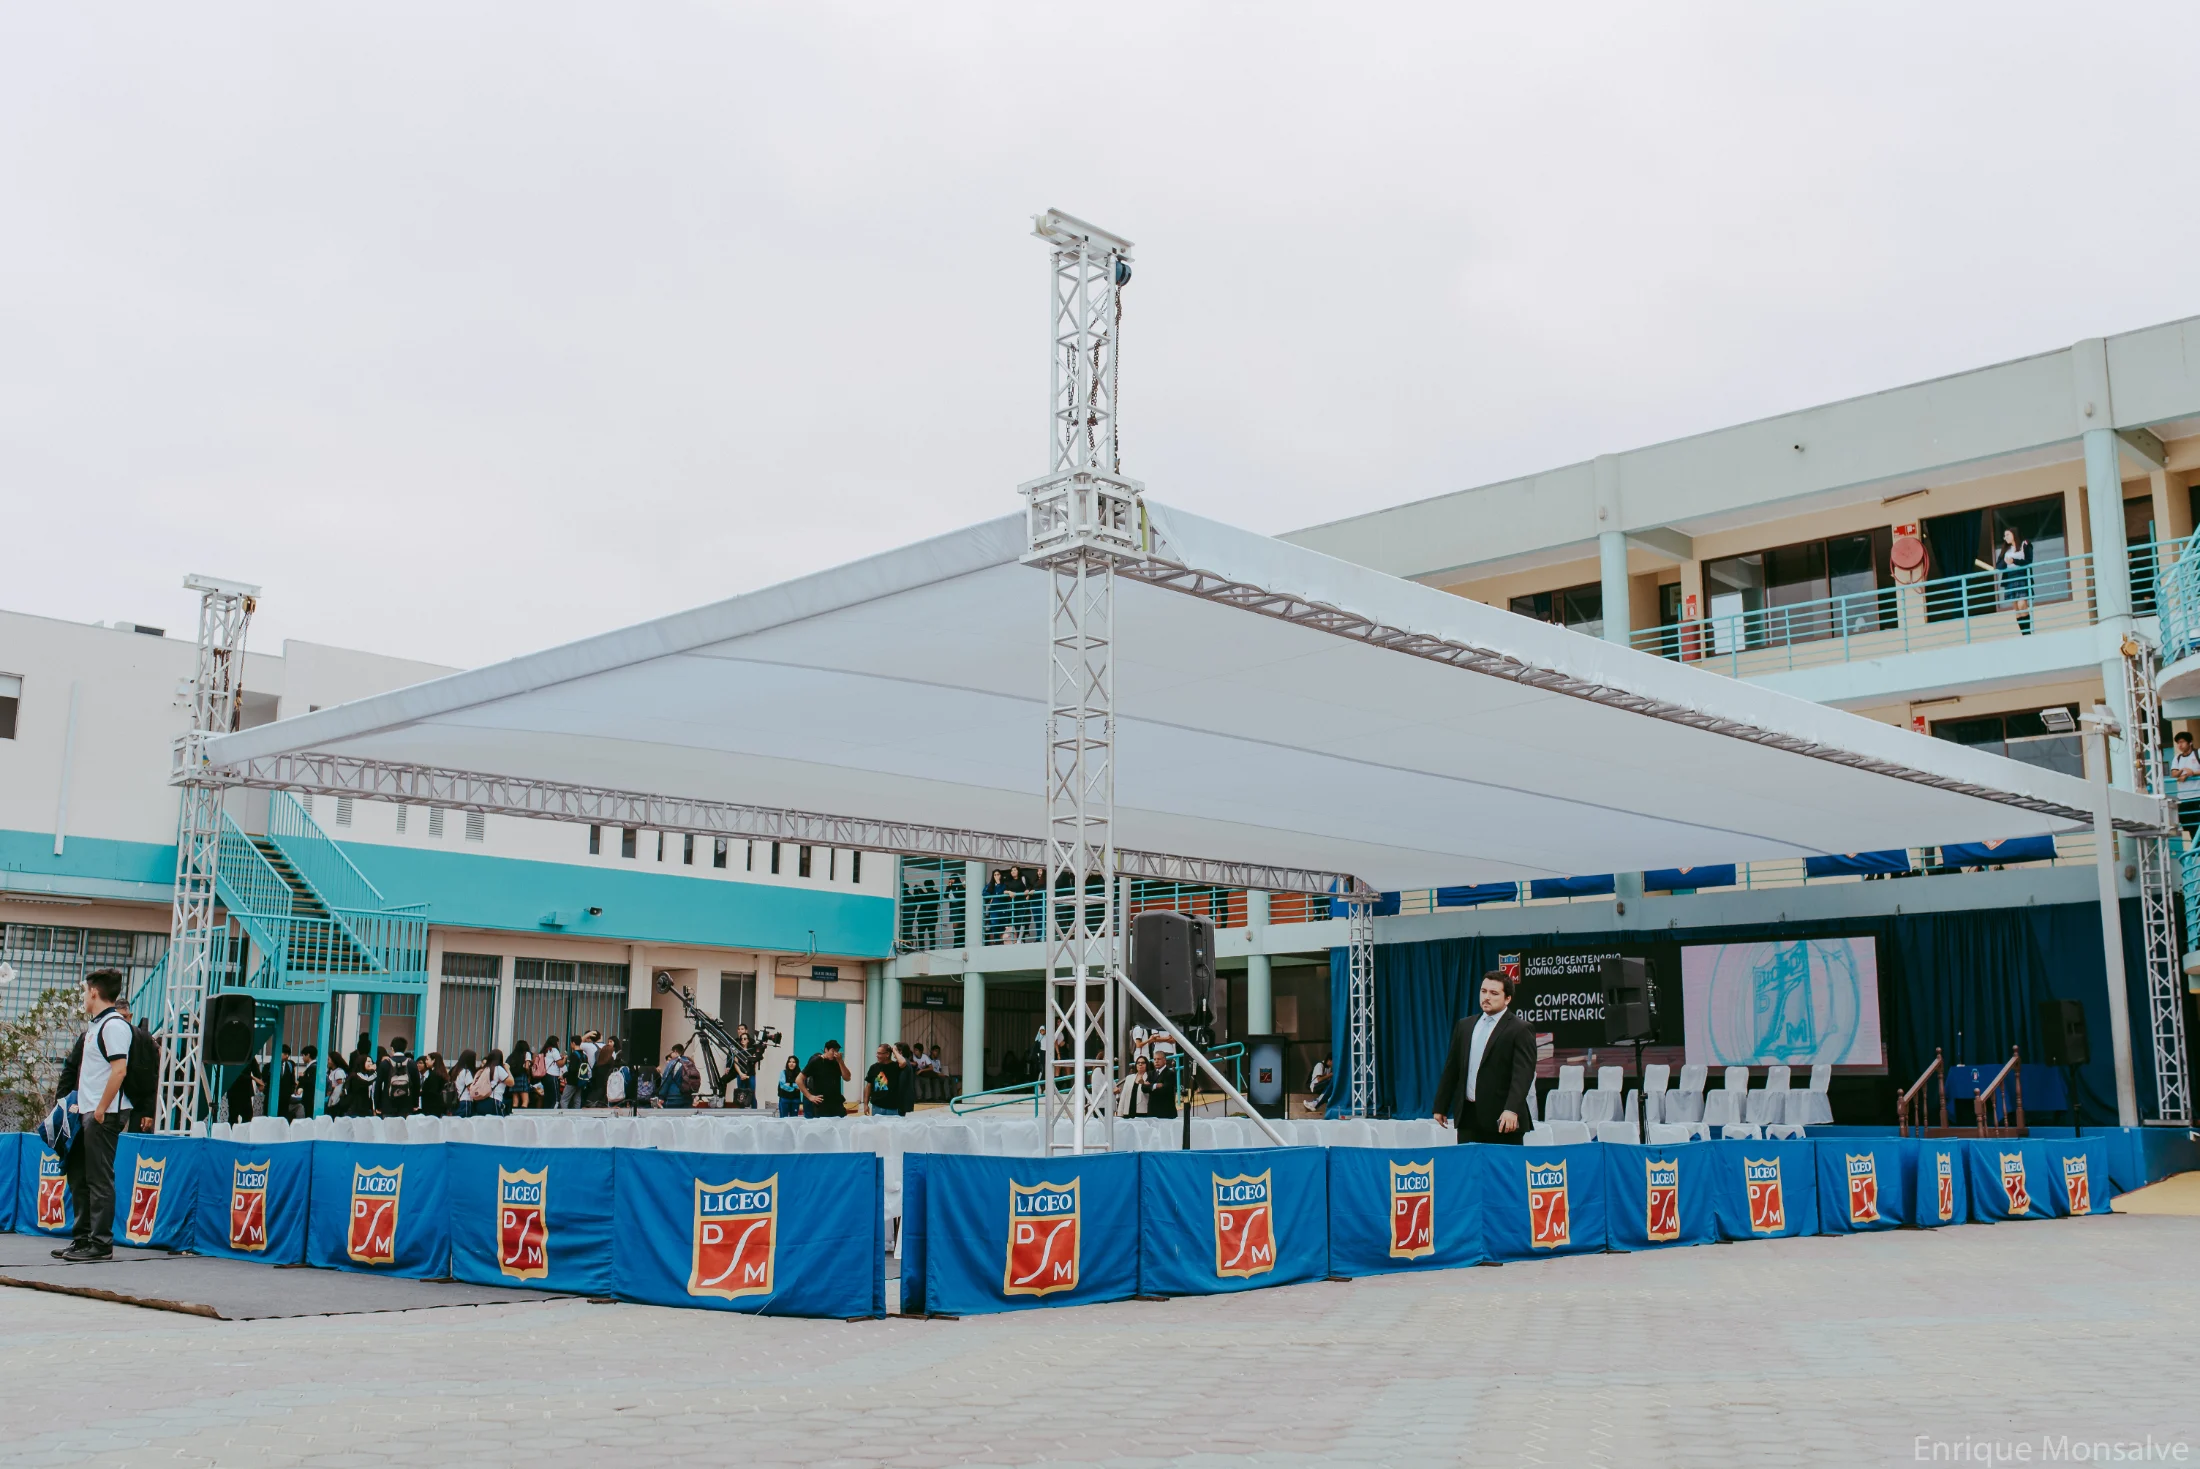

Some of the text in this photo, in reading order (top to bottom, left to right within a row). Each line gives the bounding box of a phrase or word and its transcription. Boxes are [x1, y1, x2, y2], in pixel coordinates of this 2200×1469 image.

[1528, 956, 1553, 967] LICEO
[1525, 965, 1564, 976] DOMINGO
[1566, 964, 1595, 974] SANTA
[42, 1162, 61, 1174] LICE
[1749, 1167, 1777, 1179] LICEO
[138, 1169, 160, 1184] LICEO
[236, 1172, 265, 1187] LICEO
[357, 1176, 396, 1192] LICEO
[1397, 1175, 1429, 1191] LICEO
[1530, 1172, 1563, 1186] LICEO
[1651, 1172, 1675, 1186] LICEO
[504, 1185, 540, 1202] LICEO
[1218, 1183, 1265, 1201] LICEO
[703, 1191, 770, 1212] LICEO
[1016, 1193, 1072, 1214] LICEO
